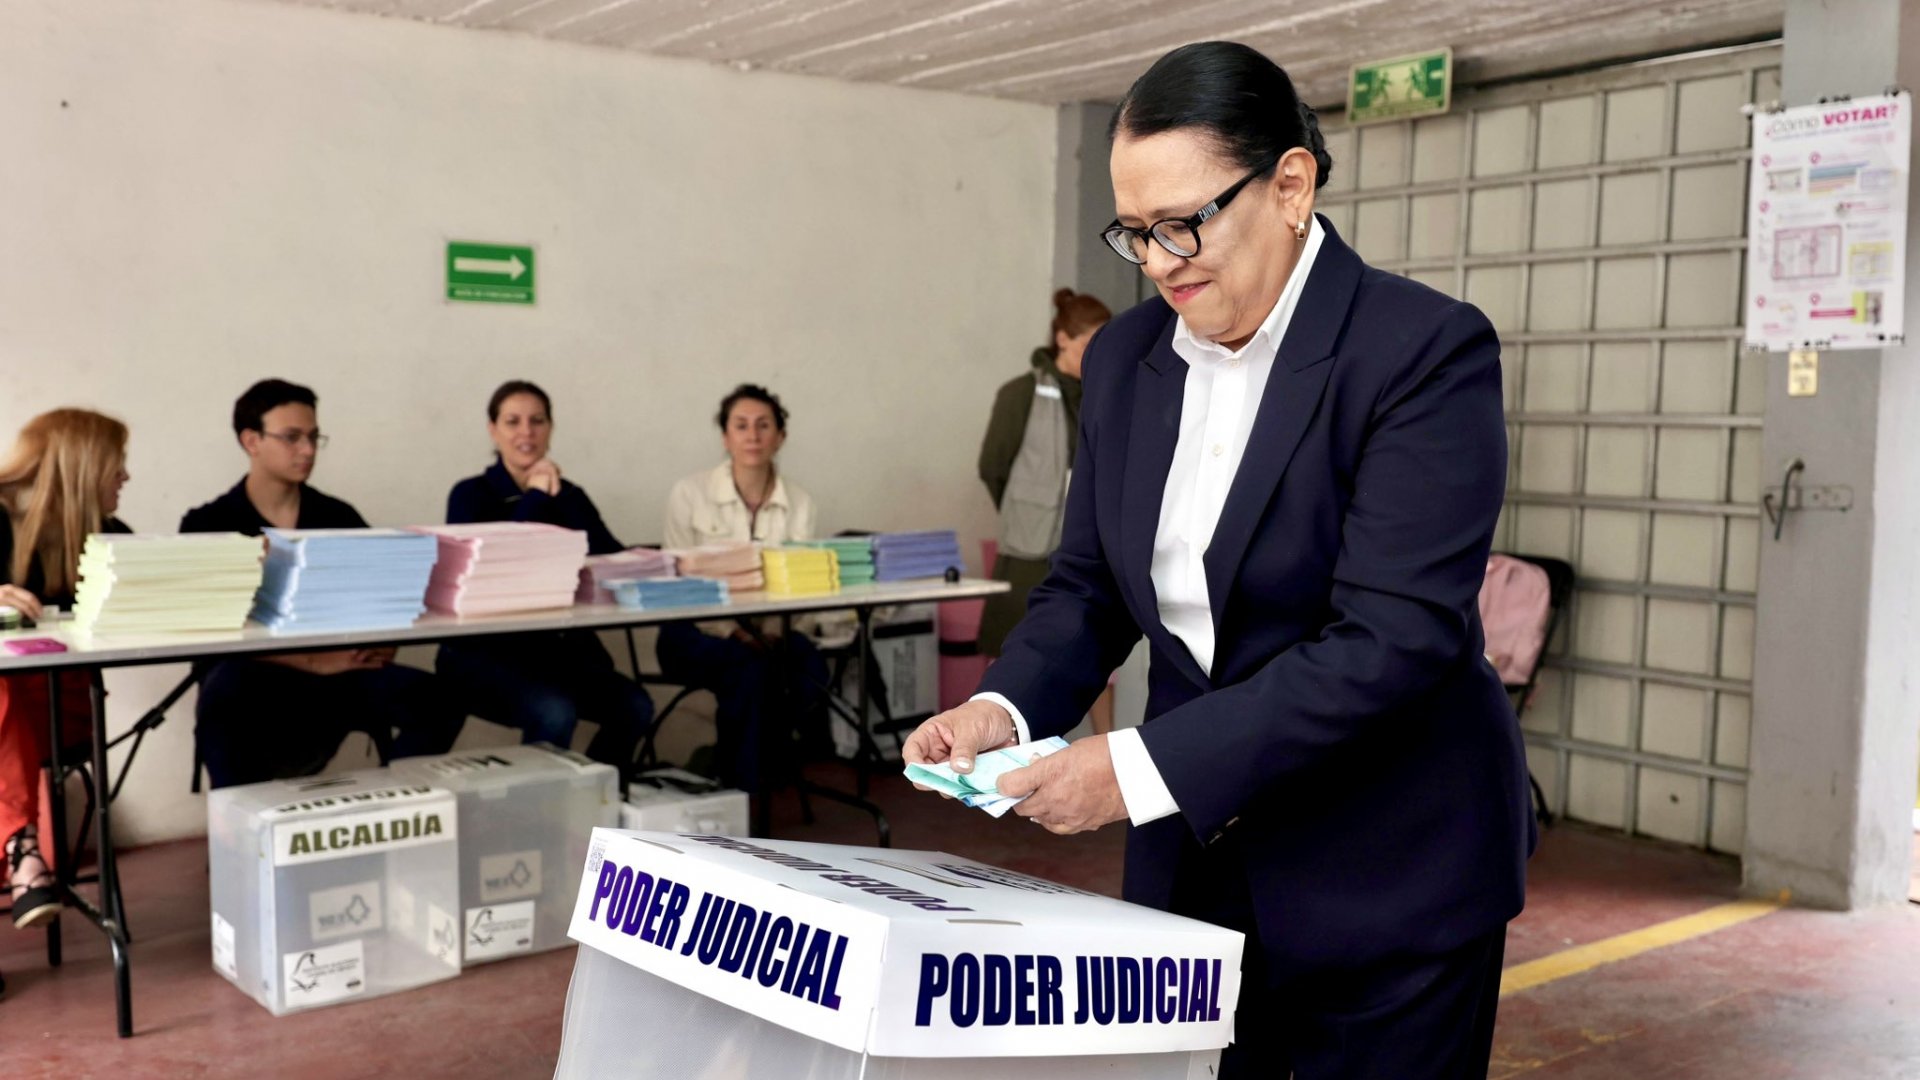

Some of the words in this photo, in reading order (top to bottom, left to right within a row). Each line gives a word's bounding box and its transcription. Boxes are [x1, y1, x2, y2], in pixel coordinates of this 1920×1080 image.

[1823, 103, 1899, 126] VOTAR?
[289, 812, 443, 855] ALCALDÍA
[818, 873, 975, 912] PODER
[588, 859, 691, 951] PODER
[680, 891, 849, 1011] JUDICIAL
[915, 952, 1064, 1029] PODER
[1074, 955, 1222, 1026] JUDICIAL
